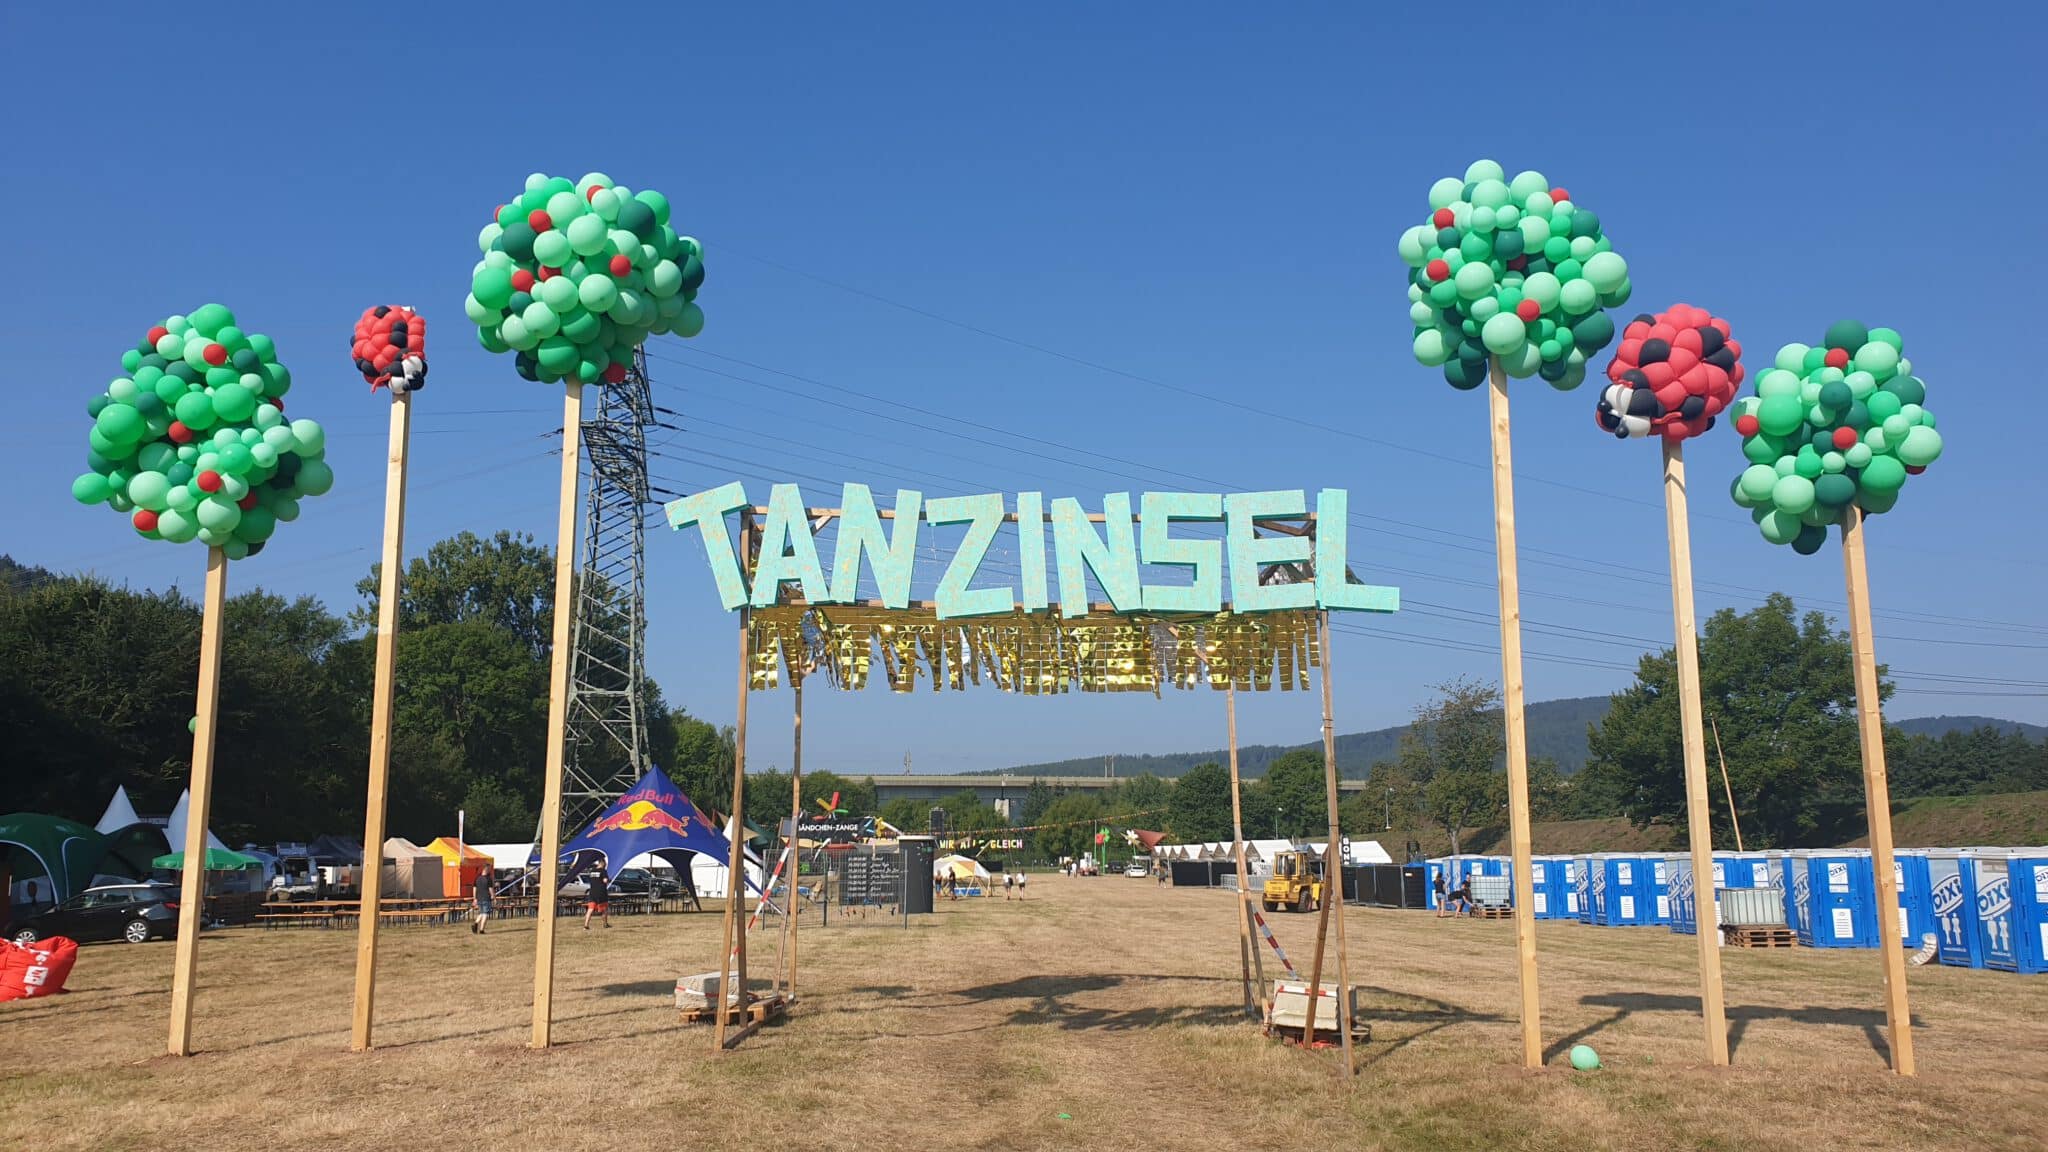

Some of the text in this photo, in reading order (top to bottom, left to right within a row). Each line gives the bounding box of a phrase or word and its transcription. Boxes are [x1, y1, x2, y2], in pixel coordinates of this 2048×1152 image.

[664, 481, 1400, 620] TANZINSEL
[645, 789, 673, 806] Bull
[991, 839, 1023, 849] GLEICH
